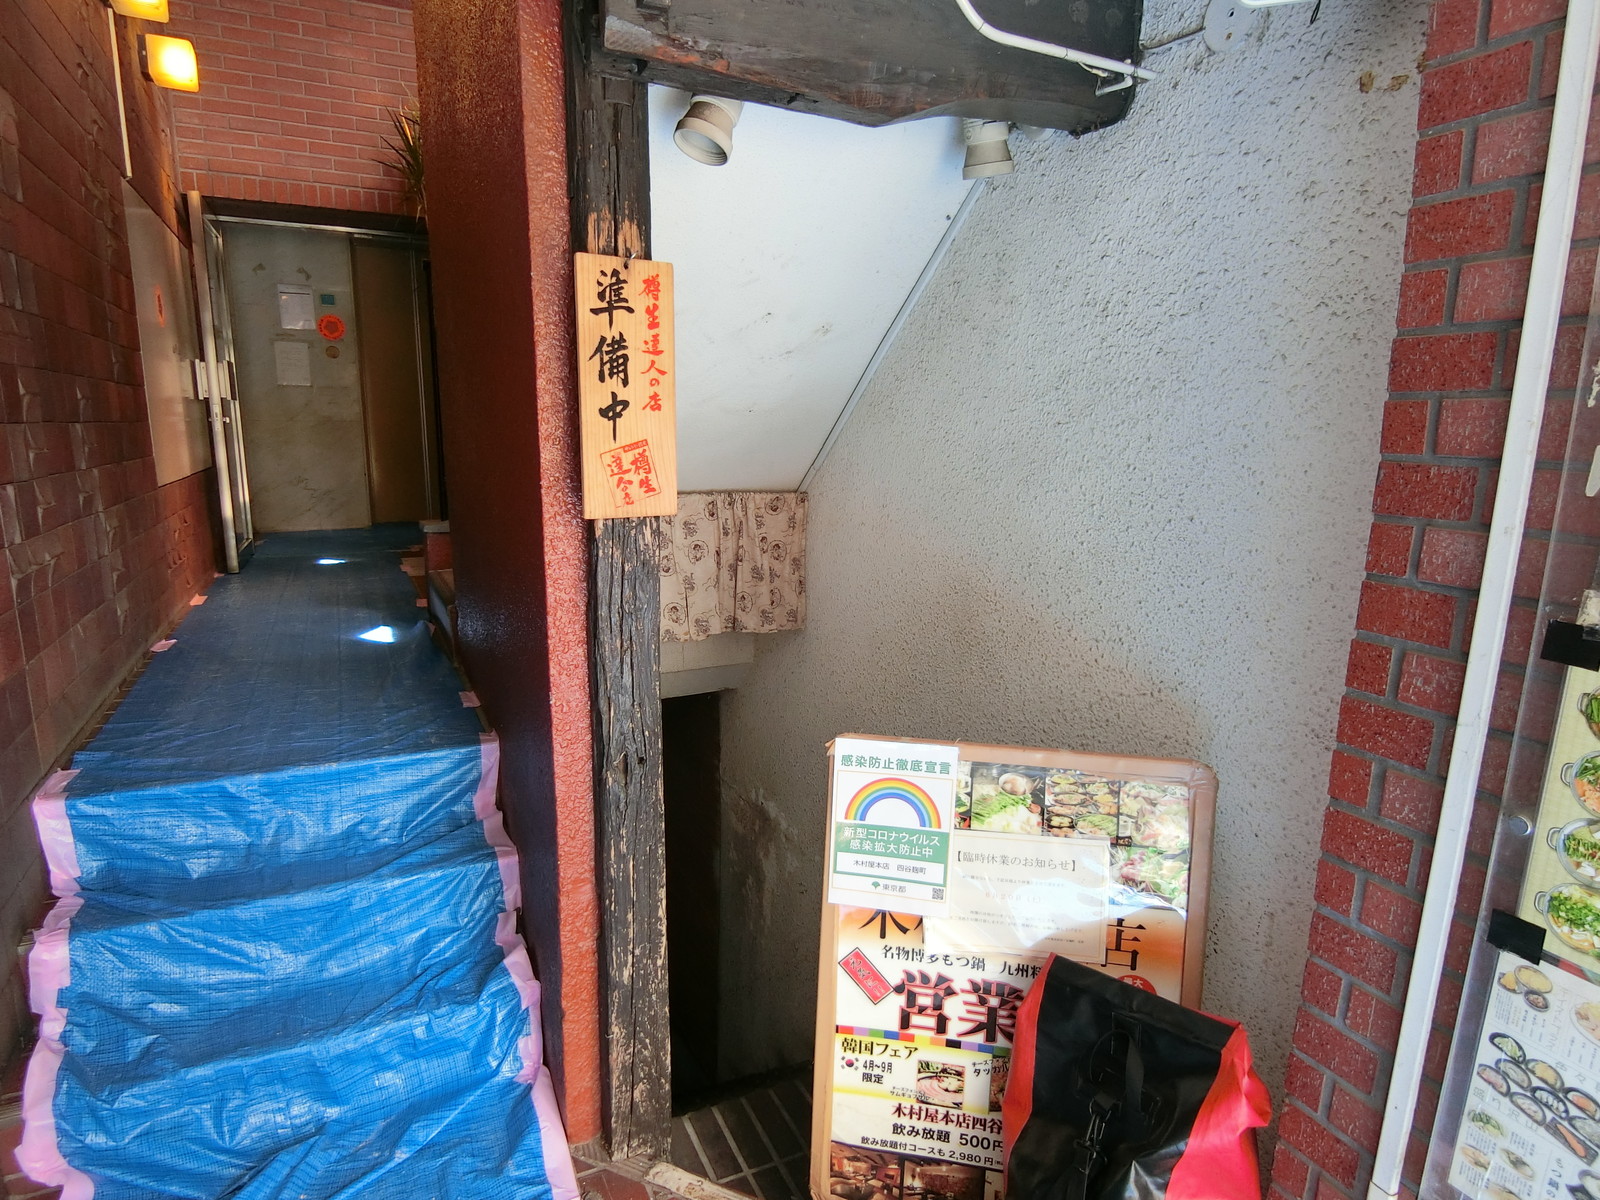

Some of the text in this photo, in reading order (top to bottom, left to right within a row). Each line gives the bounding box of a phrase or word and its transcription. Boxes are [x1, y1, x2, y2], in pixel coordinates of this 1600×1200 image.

[587, 267, 635, 443] 準備中
[840, 754, 952, 775] 感染防止徹底宣言
[843, 826, 941, 847] 新型コロナウイルス
[849, 839, 934, 859] 感染拡大防止中
[853, 859, 890, 871] 木村屋本店
[956, 850, 1077, 872] 【臨時休業のお知らせ】
[882, 883, 907, 894] 東京都
[881, 944, 986, 972] 名物博多もつ鍋
[893, 968, 1024, 1045] 営業
[841, 1036, 919, 1059] 韓国フェア
[861, 1072, 885, 1086] 限定
[892, 1103, 1003, 1135] 木村屋本店四谷
[892, 1122, 1004, 1153] 飲み放題 500円
